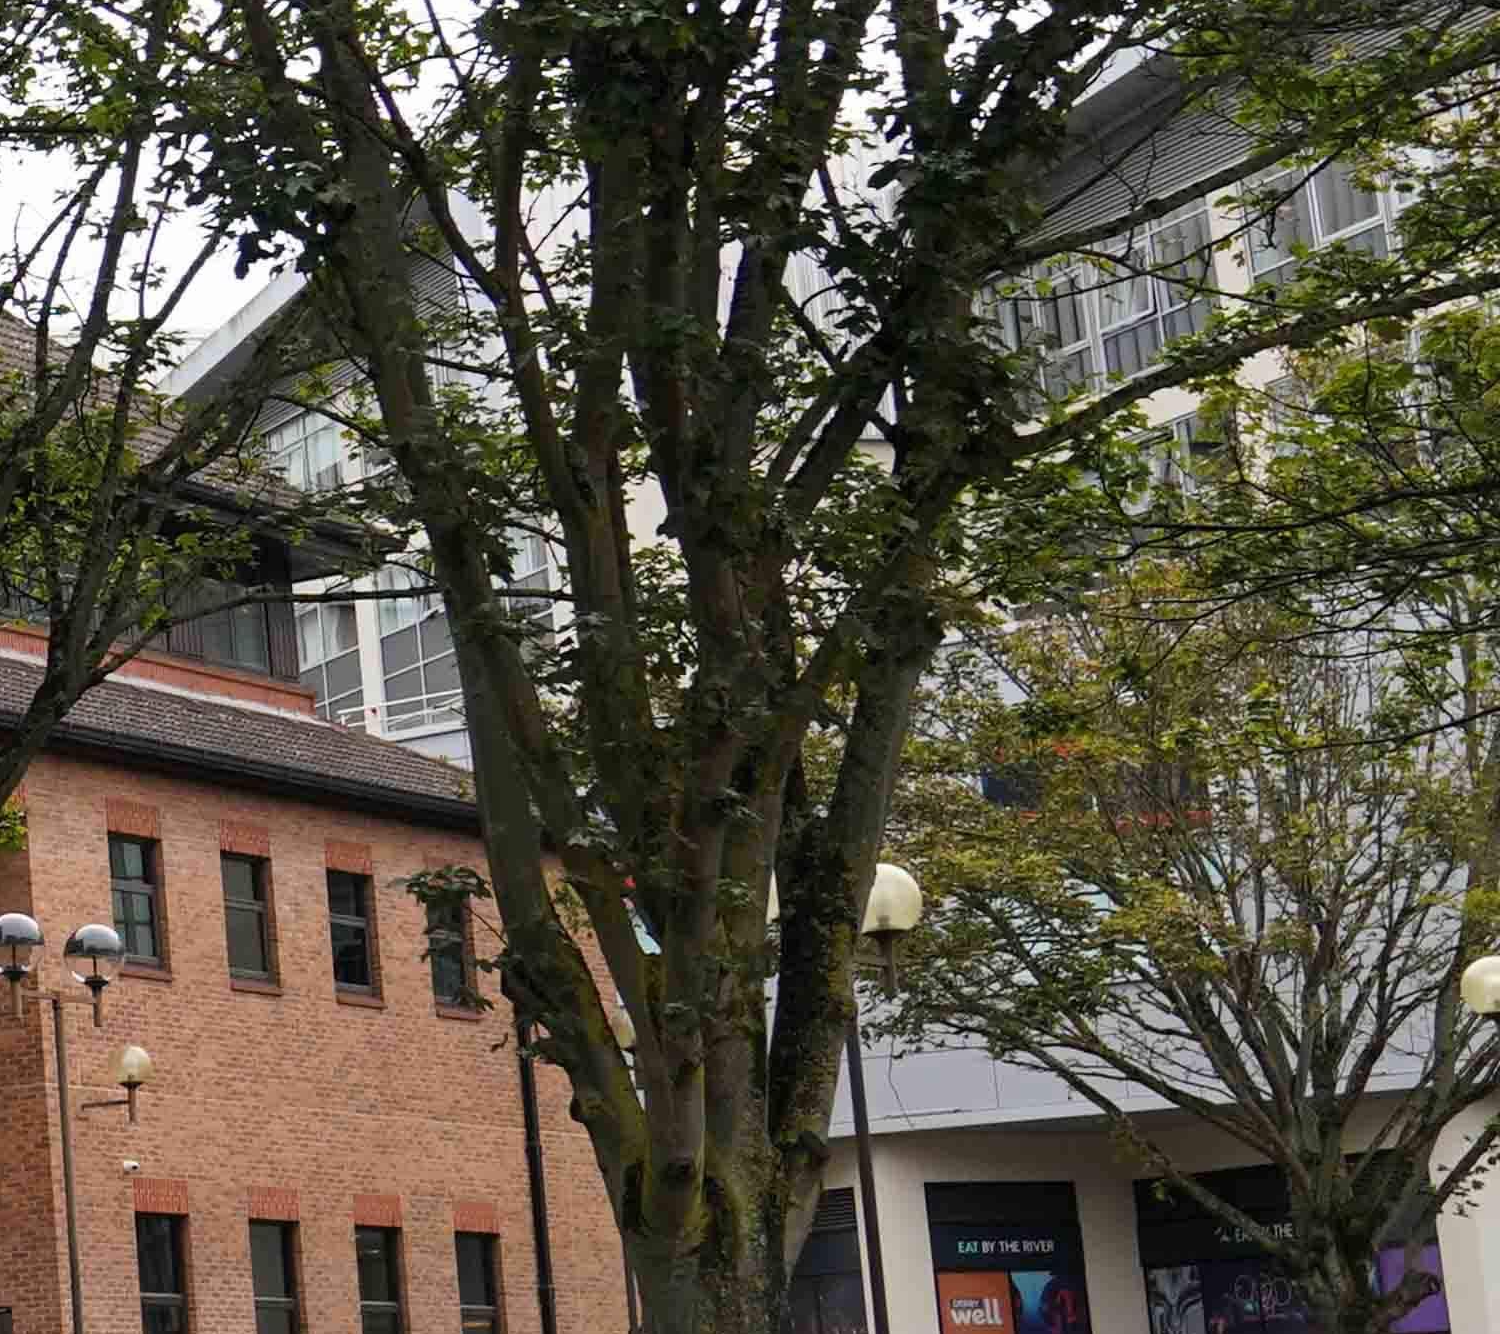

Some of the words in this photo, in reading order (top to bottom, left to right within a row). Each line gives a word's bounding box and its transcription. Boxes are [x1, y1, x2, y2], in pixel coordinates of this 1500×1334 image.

[957, 1241, 979, 1253] EAT
[981, 1241, 997, 1253] BY
[999, 1241, 1020, 1253] THE
[1023, 1241, 1054, 1253] RIVER
[950, 1298, 1004, 1324] well
